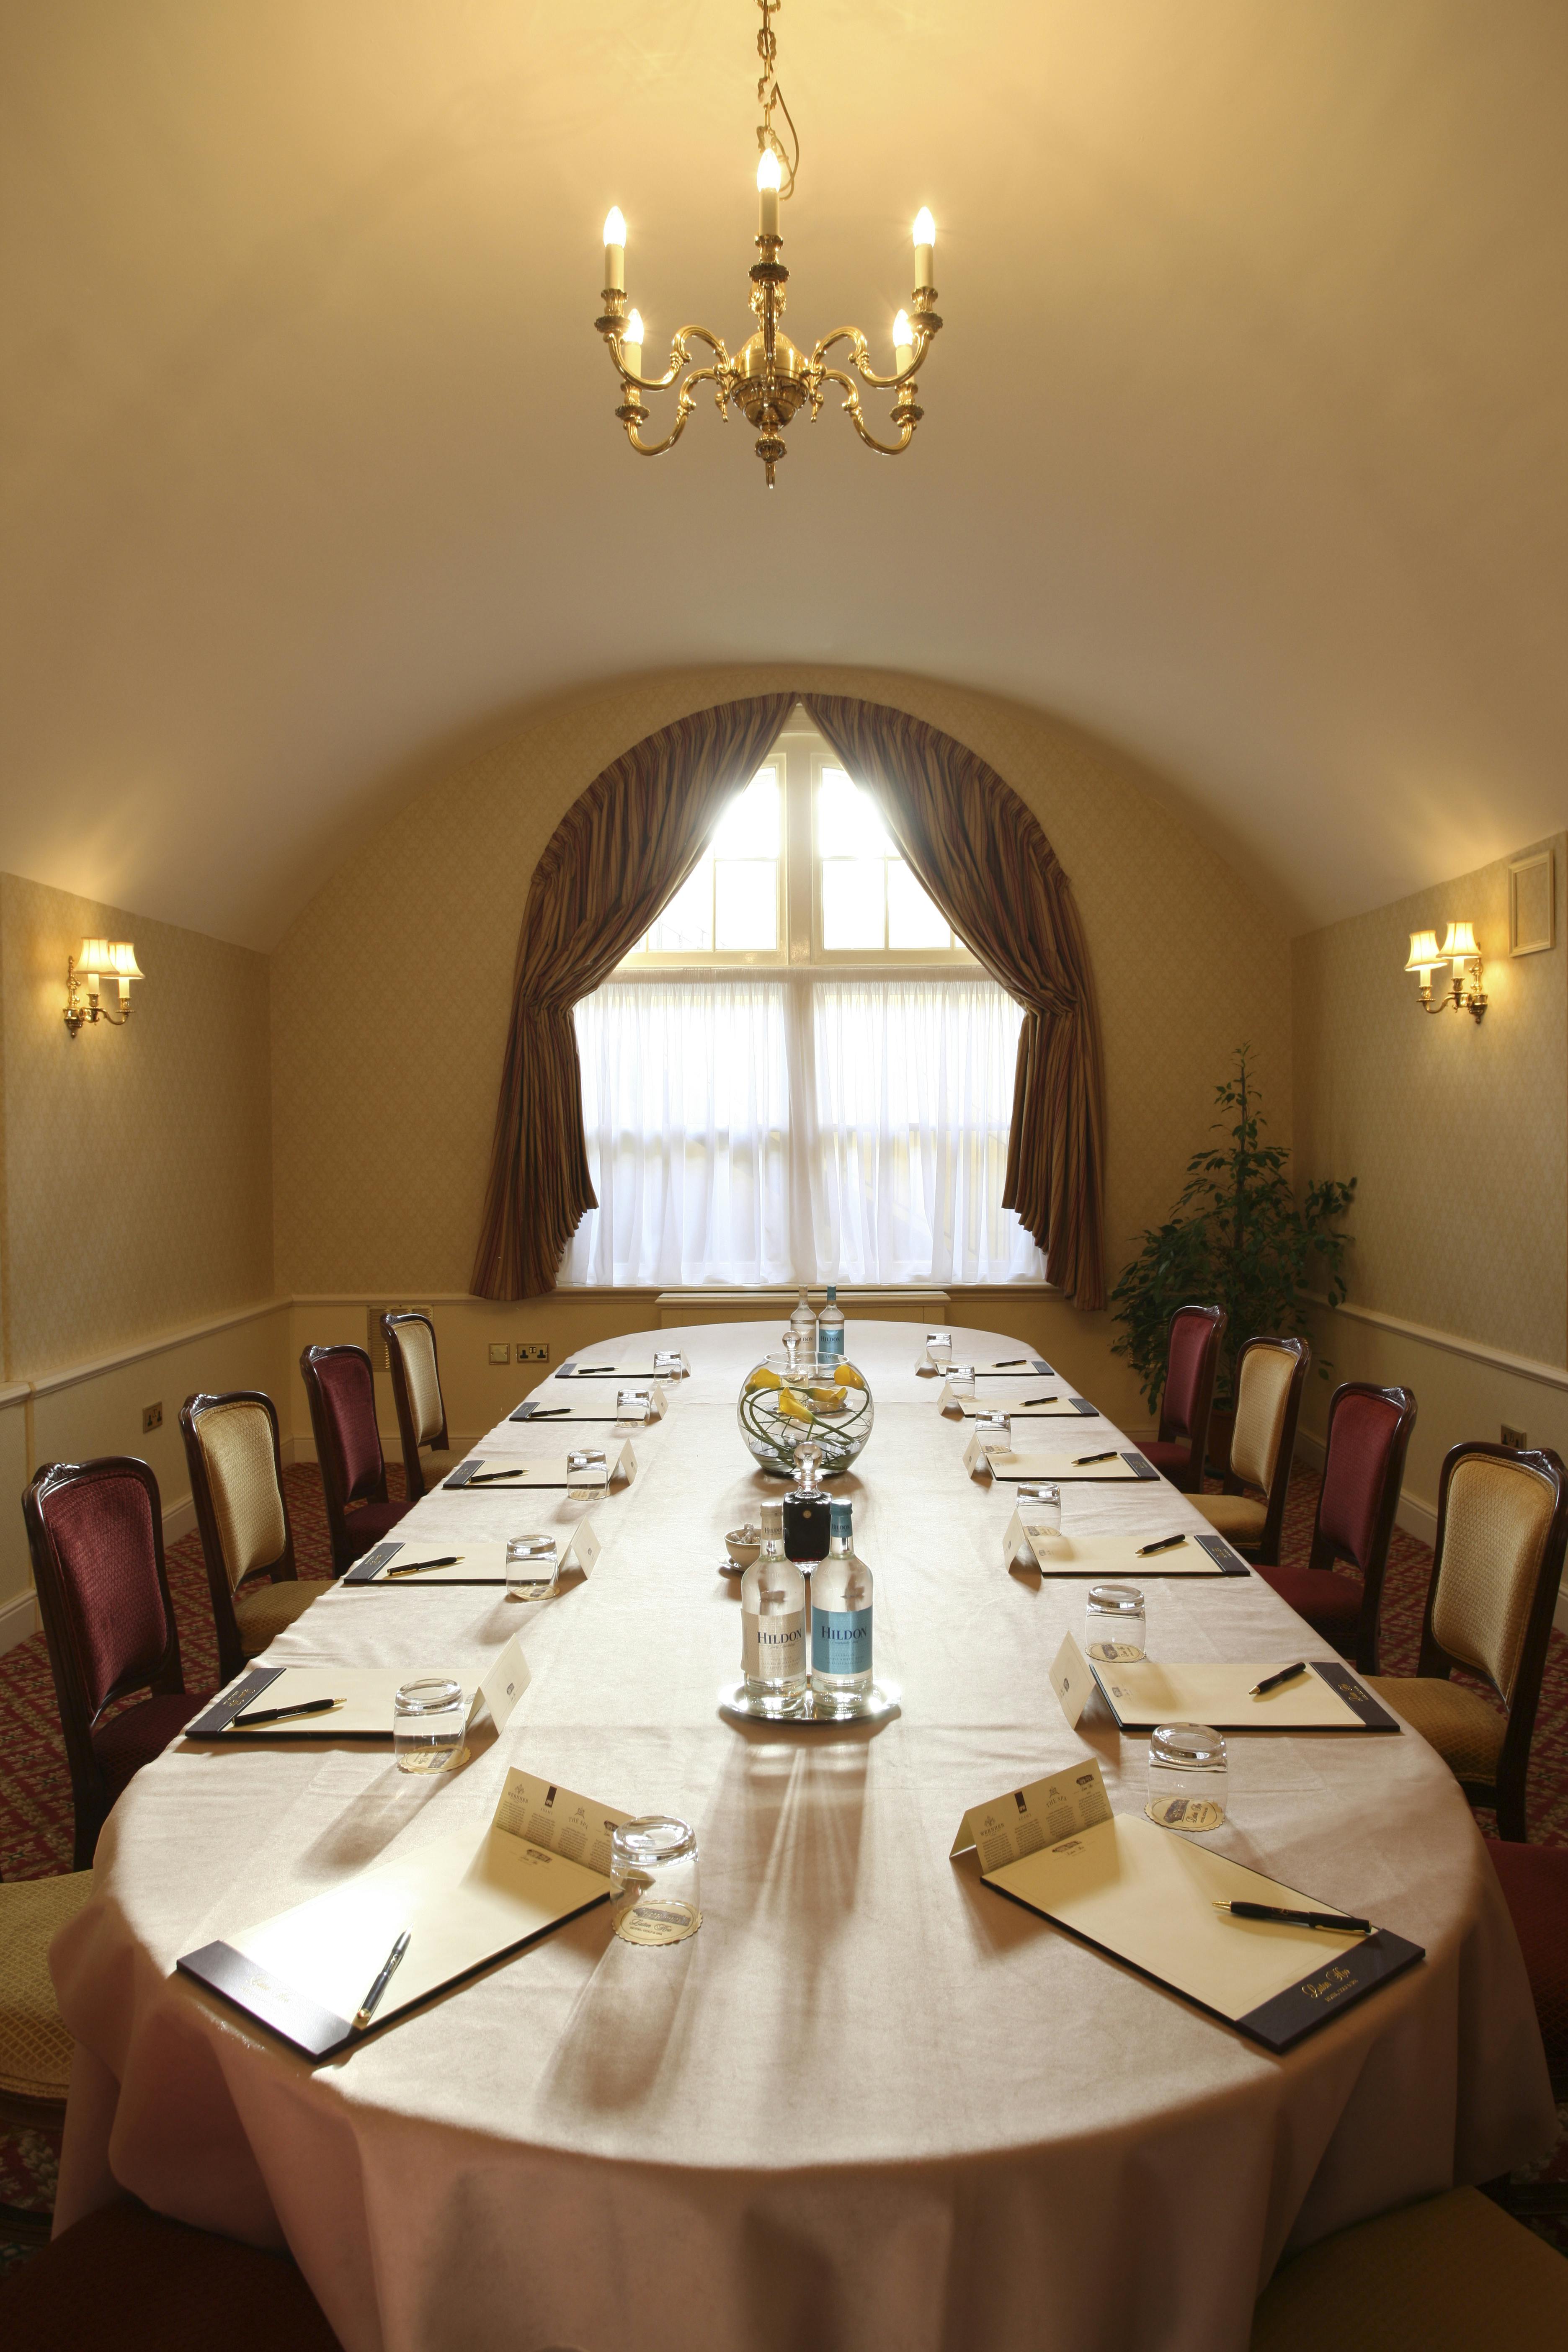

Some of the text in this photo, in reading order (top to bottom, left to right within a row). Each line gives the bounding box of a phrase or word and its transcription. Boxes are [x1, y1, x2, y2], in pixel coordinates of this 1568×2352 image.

[757, 1628, 802, 1644] HILDON
[821, 1626, 867, 1640] HILDON
[1046, 1798, 1057, 1808] THE
[580, 1820, 588, 1830] SPA
[980, 1823, 1005, 1836] WERNHER
[629, 1918, 672, 1932] Luton Hoo
[1301, 1981, 1332, 1998] Luton
